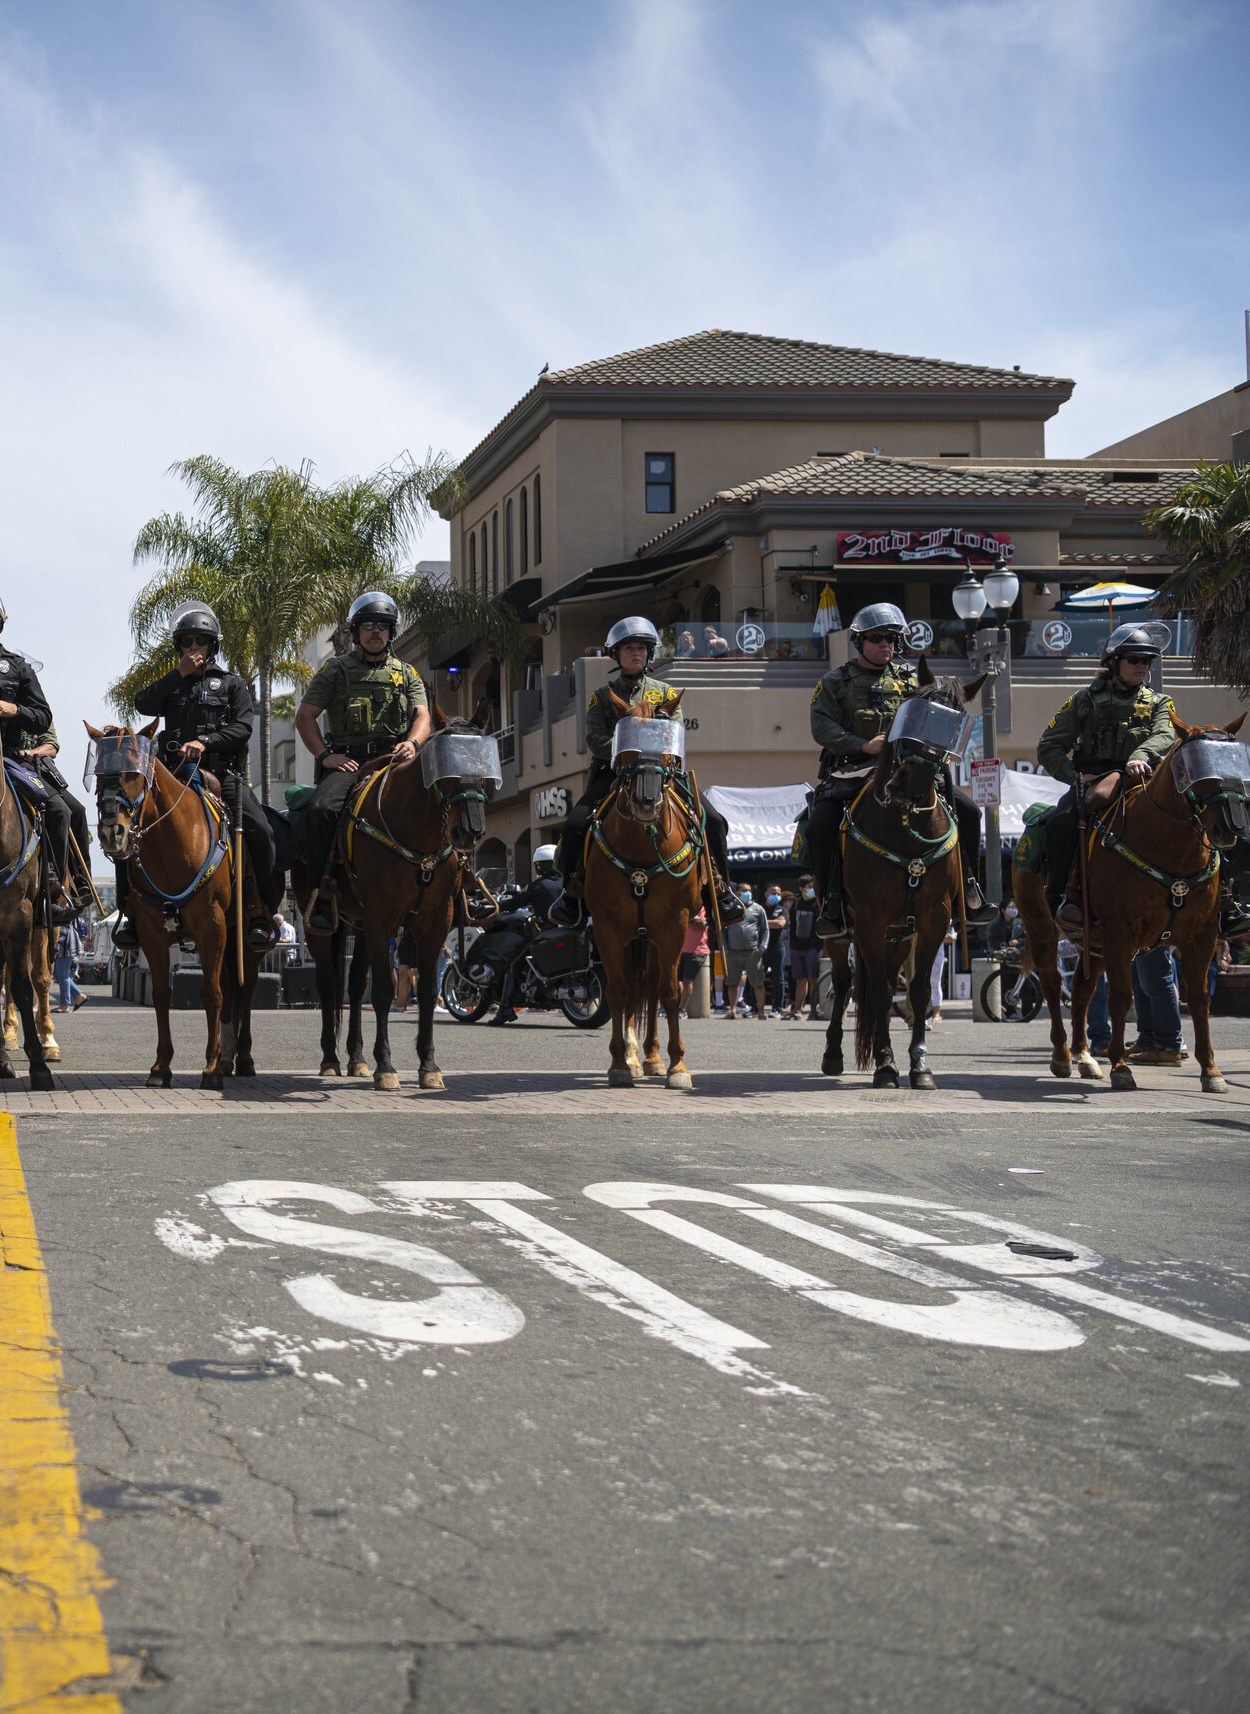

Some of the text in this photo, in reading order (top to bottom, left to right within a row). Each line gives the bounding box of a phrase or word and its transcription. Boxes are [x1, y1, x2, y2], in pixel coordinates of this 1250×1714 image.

[843, 528, 1015, 558] 2nd Floor
[192, 863, 216, 892] POLICE
[156, 1178, 1250, 1380] STOP
